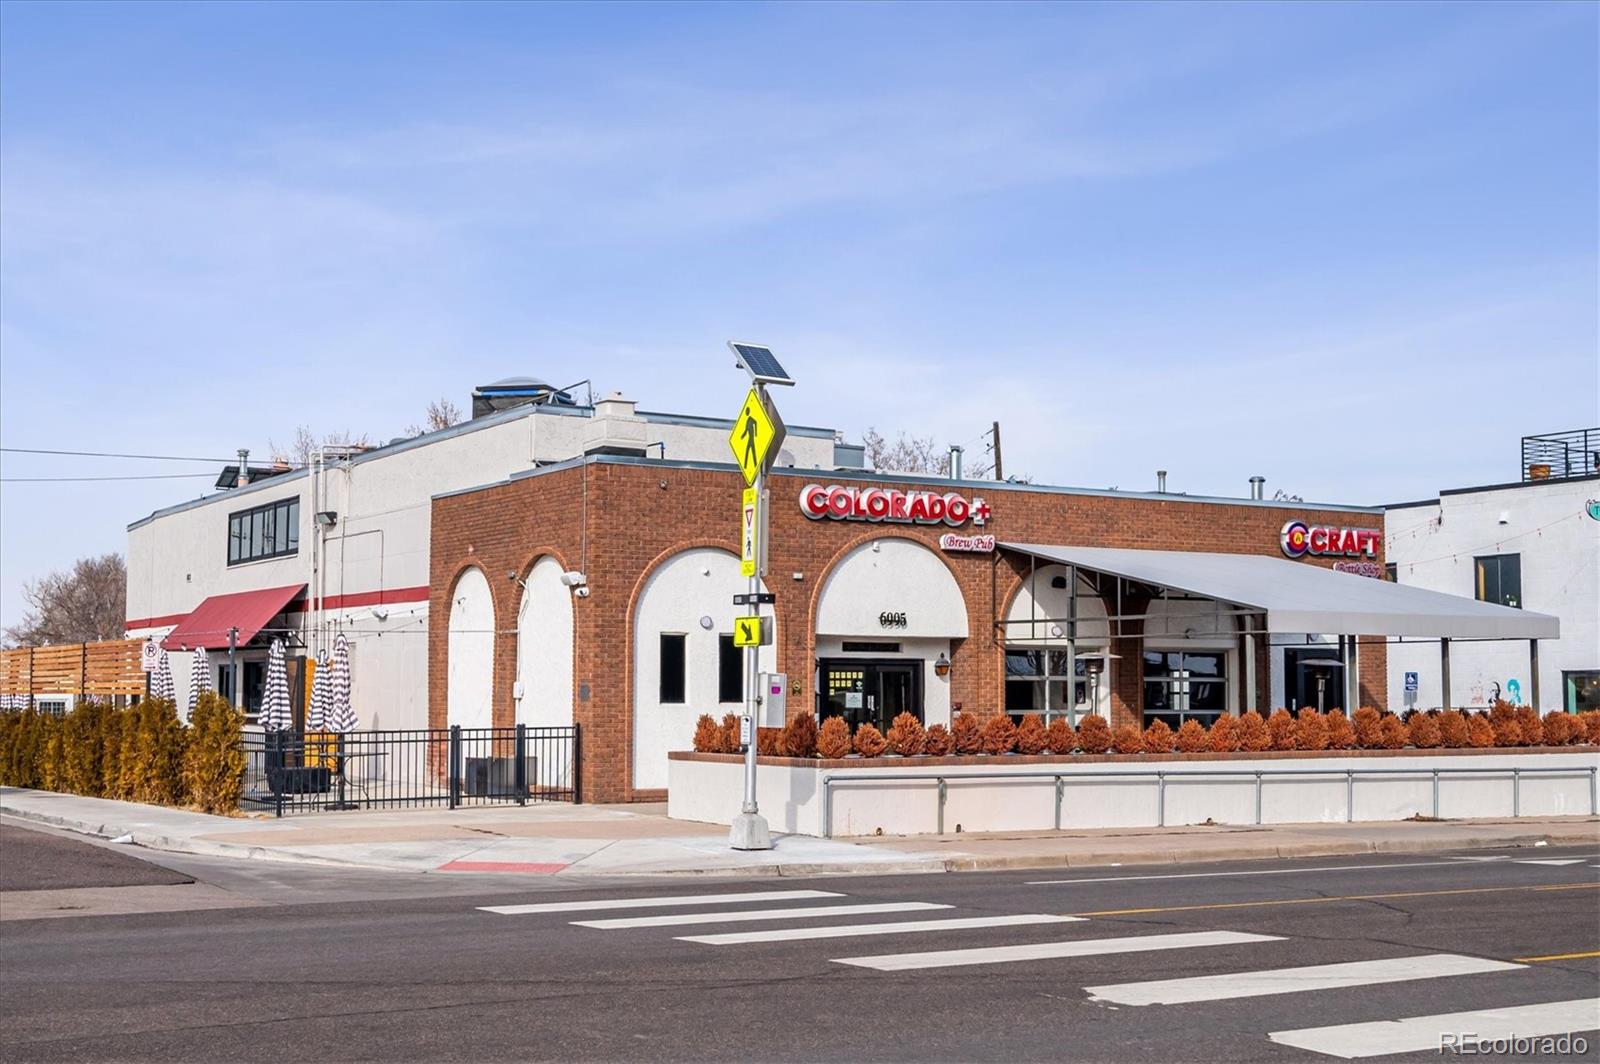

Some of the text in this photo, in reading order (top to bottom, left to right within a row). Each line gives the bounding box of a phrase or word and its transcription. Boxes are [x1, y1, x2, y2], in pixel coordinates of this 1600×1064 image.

[803, 485, 969, 524] COLORADO
[946, 535, 993, 549] Brew Pub
[1309, 527, 1379, 556] CRAFT
[879, 611, 907, 627] 6995
